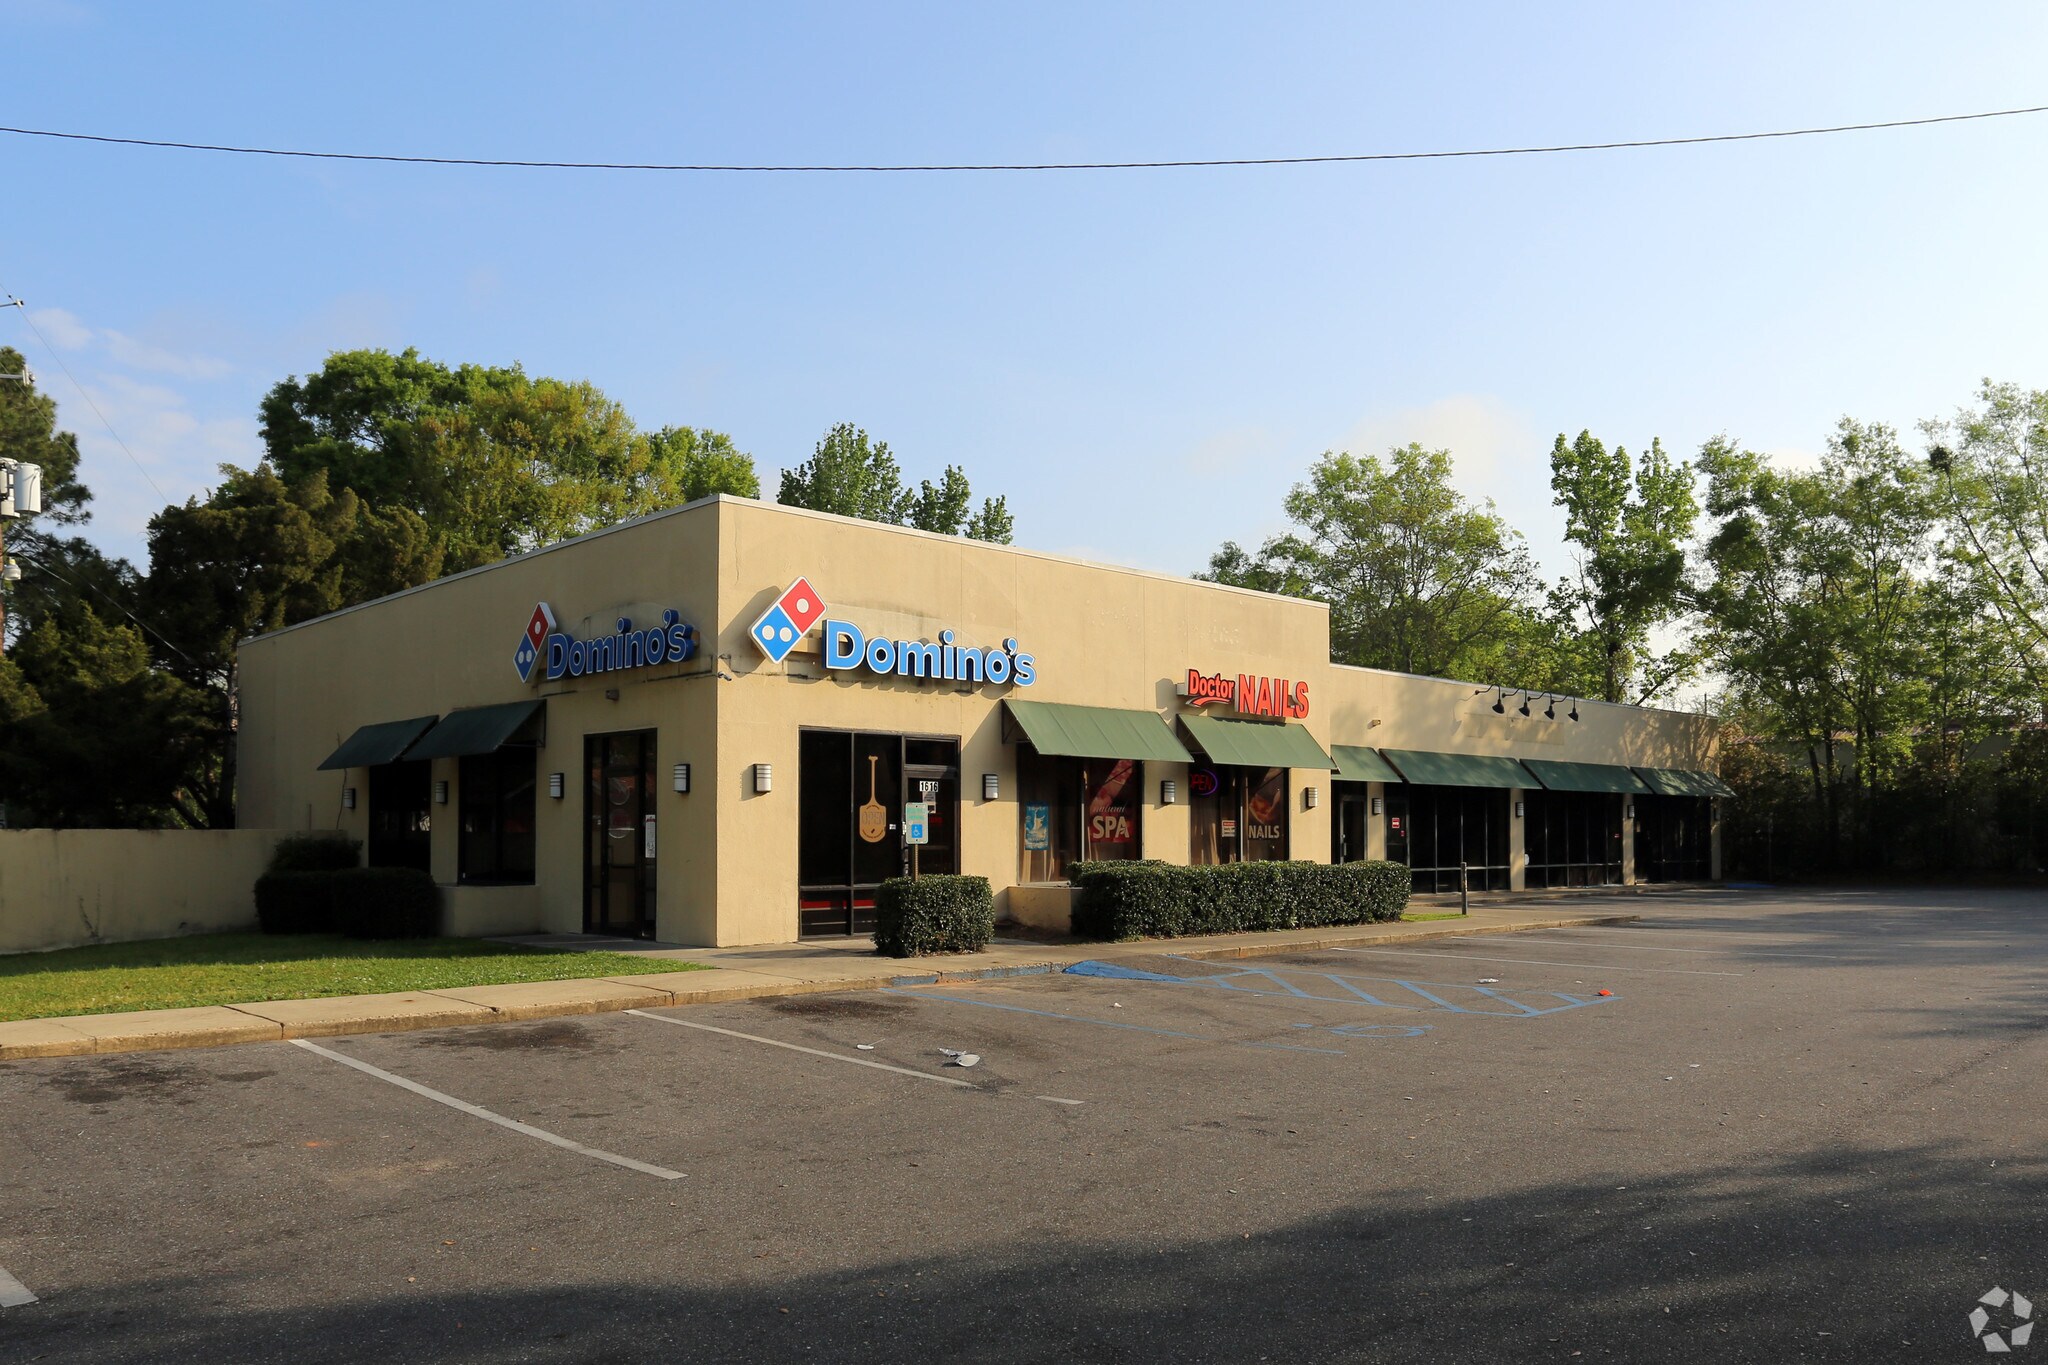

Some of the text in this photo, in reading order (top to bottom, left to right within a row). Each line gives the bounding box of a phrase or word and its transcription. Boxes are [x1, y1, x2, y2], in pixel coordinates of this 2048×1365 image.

[546, 608, 689, 680] Domino's
[824, 618, 1037, 688] Domino's
[1187, 668, 1310, 719] Doctor NAILS
[920, 781, 938, 792] 1616
[1190, 773, 1212, 791] PEN
[1092, 815, 1130, 839] SPA
[1248, 824, 1280, 839] NAILS
